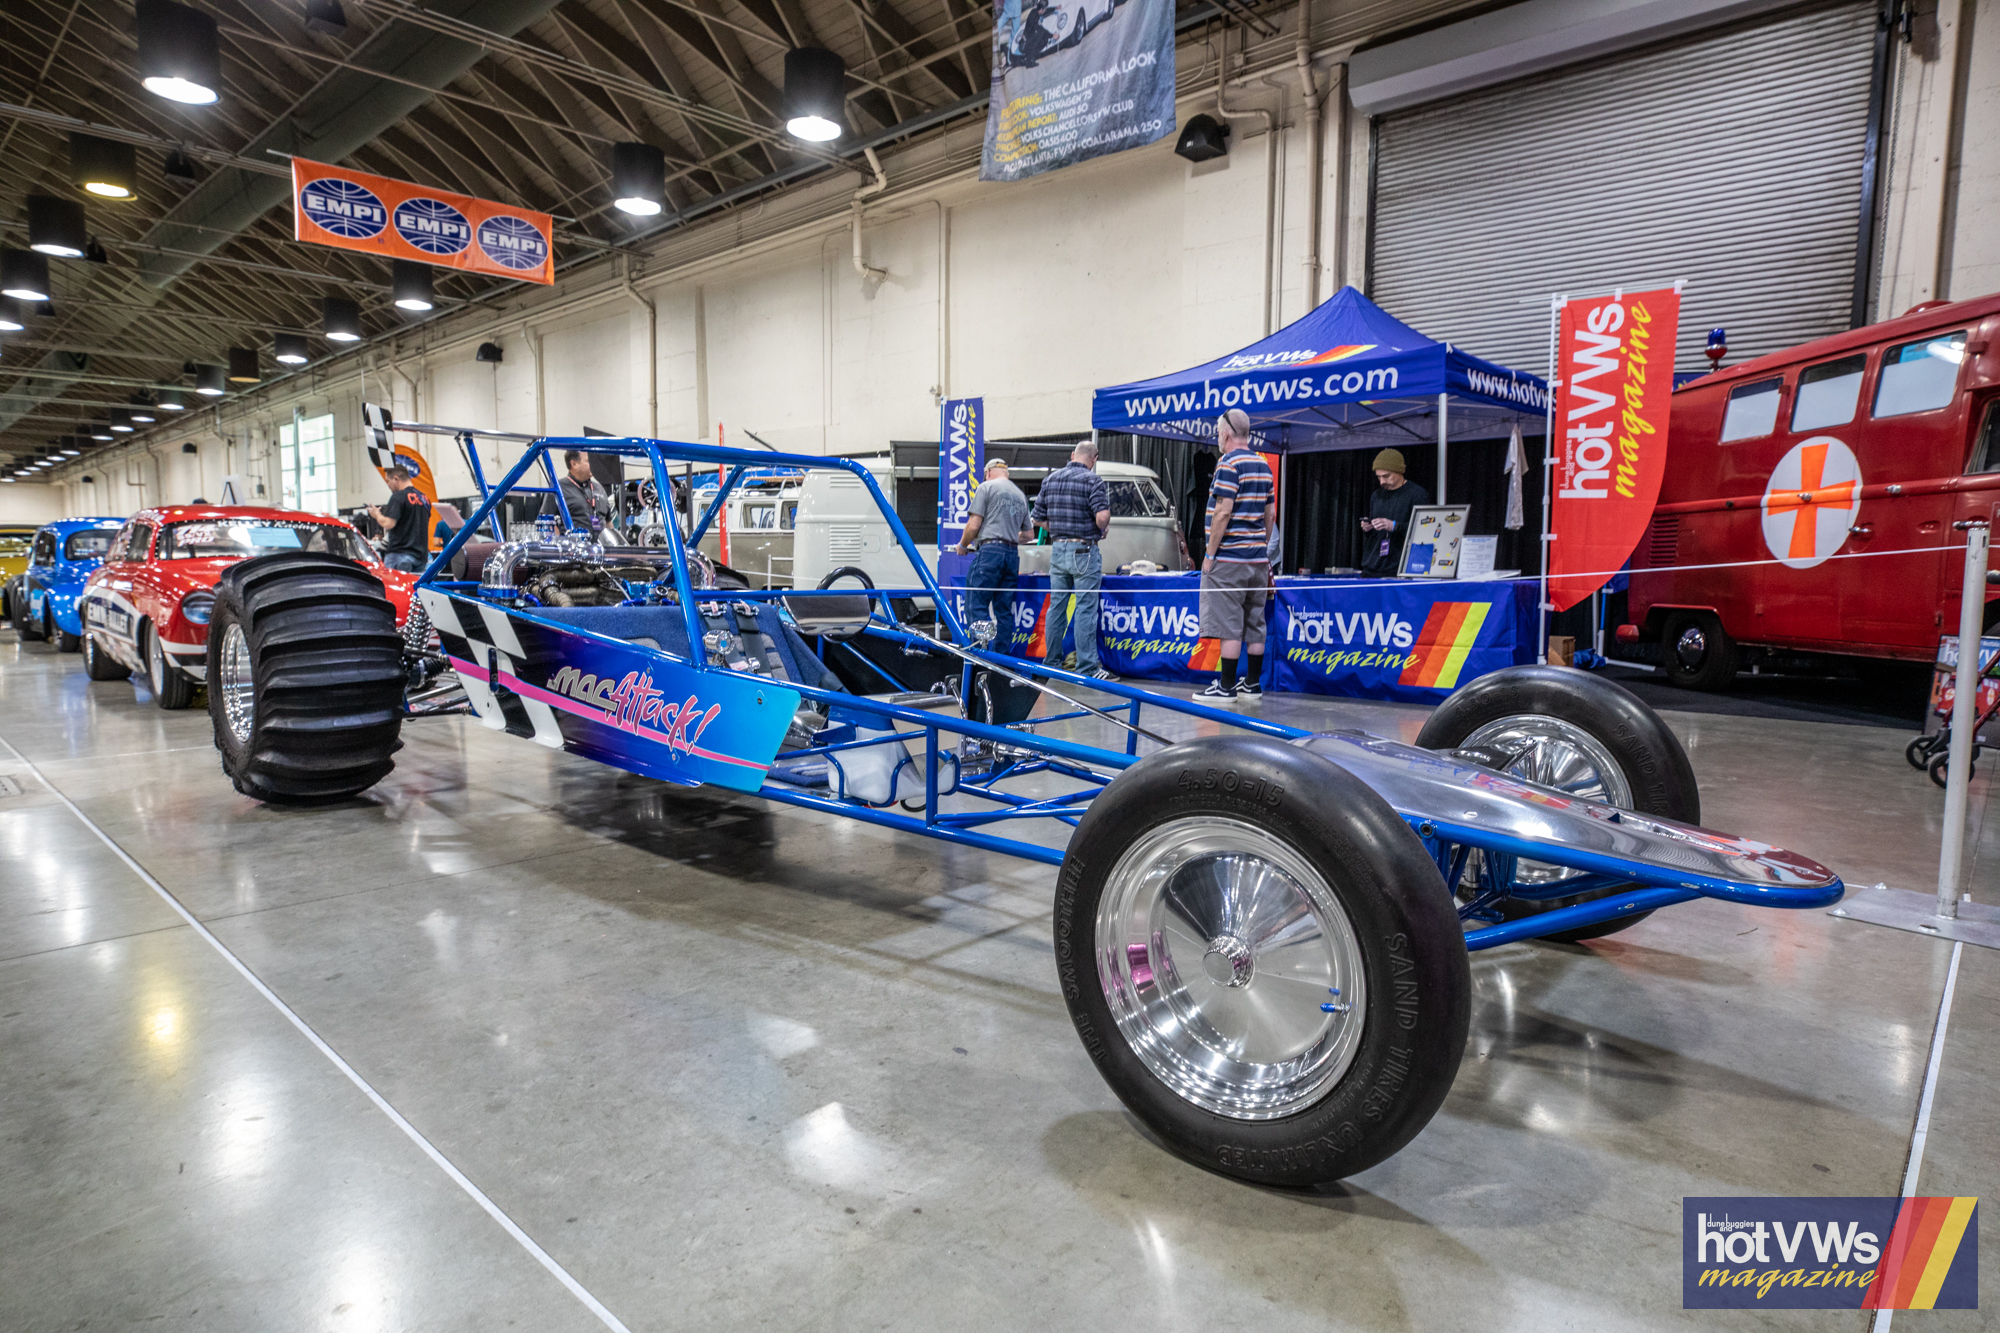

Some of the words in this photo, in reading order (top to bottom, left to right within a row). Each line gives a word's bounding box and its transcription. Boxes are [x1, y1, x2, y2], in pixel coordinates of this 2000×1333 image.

[1044, 85, 1061, 102] THE
[1122, 50, 1157, 73] LOOK
[1021, 128, 1043, 143] VOLKS
[1111, 99, 1134, 114] CLUB
[1030, 93, 1081, 117] VOLKSWAGEN
[1058, 106, 1076, 121] AUDI
[1140, 119, 1162, 133] 250
[306, 194, 382, 222] EMPI
[400, 215, 468, 239] EMPI
[482, 230, 544, 254] EMPI
[1567, 303, 1625, 422] VWs
[1125, 367, 1399, 417] www.hotvws.com
[1615, 301, 1656, 498] magazine
[1559, 422, 1615, 498] hot
[217, 520, 272, 529] KELLEY
[1100, 599, 1139, 633] hot
[1139, 605, 1200, 637] VWs
[1287, 605, 1333, 644] hot
[1334, 612, 1413, 648] VWs
[1104, 636, 1205, 660] magazine
[1287, 647, 1420, 675] magazine
[1178, 768, 1285, 807] 4.50-15
[1385, 932, 1419, 1030] SAND
[1075, 1012, 1107, 1061] THE
[1363, 1045, 1414, 1121] TIRES
[1216, 1121, 1364, 1172] UNLIMITED
